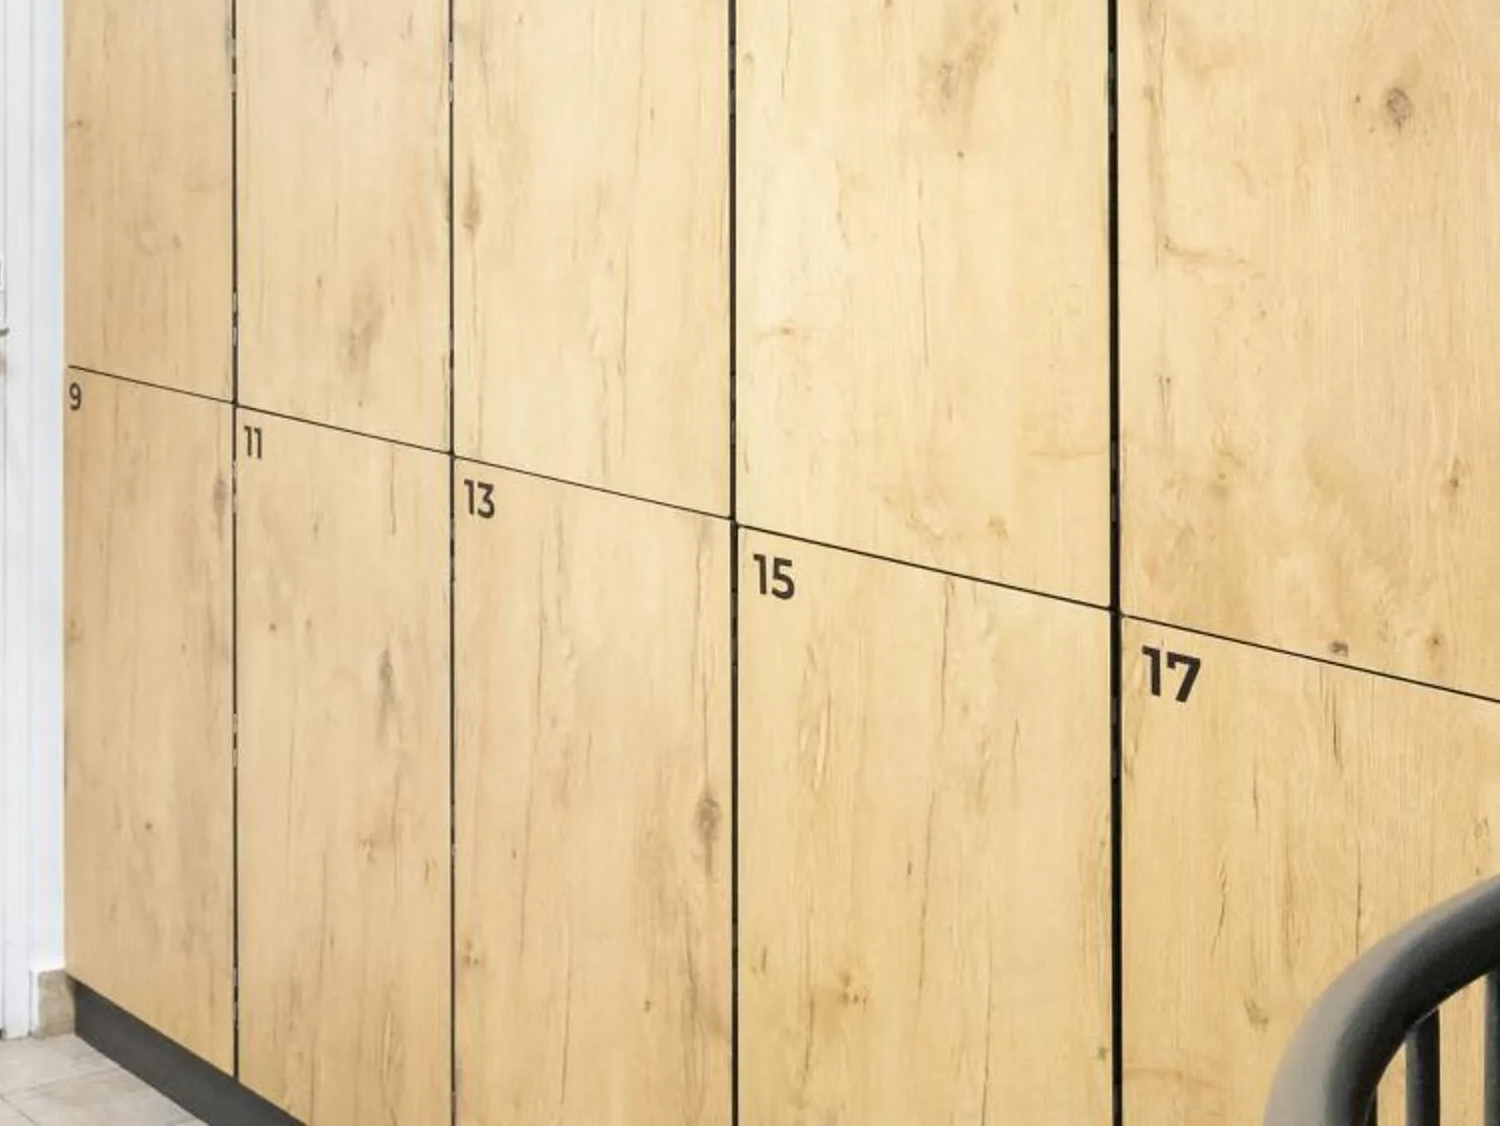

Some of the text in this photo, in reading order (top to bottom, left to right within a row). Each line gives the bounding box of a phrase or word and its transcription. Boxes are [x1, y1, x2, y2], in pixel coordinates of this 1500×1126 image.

[70, 382, 83, 412] 9
[244, 426, 264, 460] 11
[463, 479, 496, 521] 13
[753, 554, 797, 602] 15
[1142, 646, 1202, 704] 17
